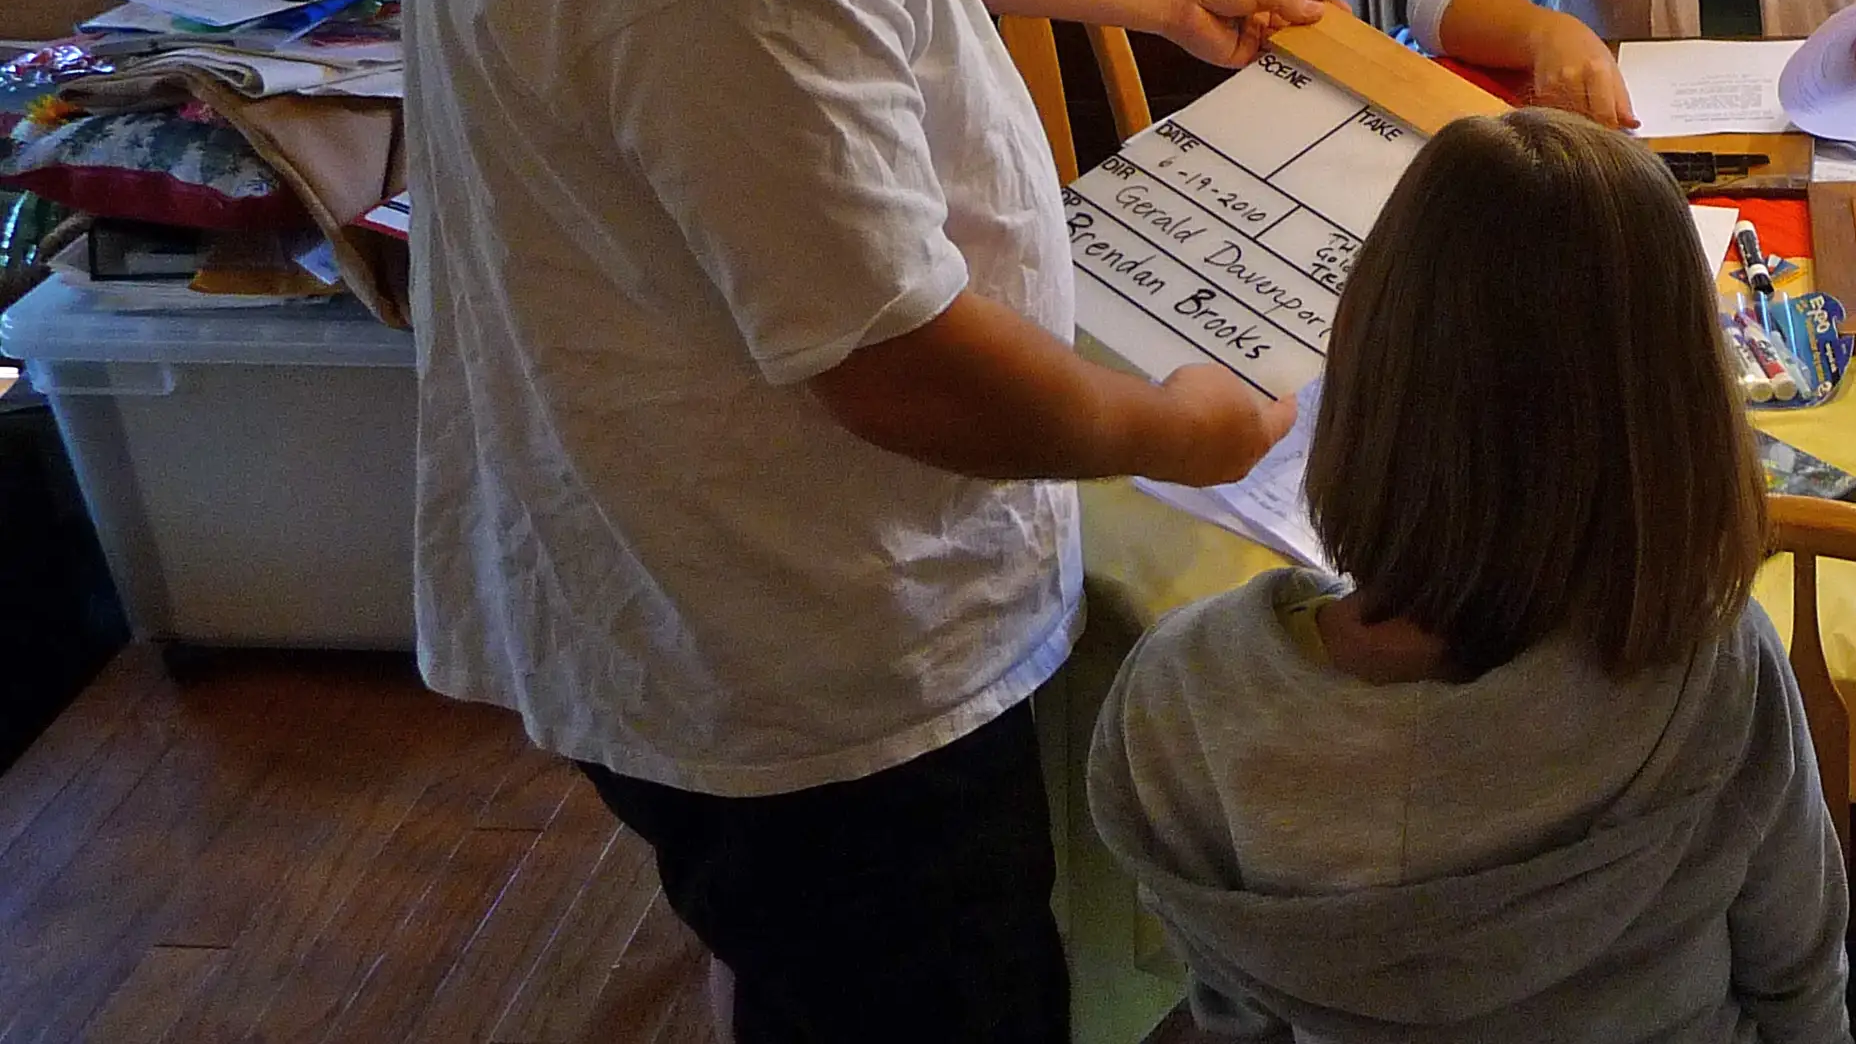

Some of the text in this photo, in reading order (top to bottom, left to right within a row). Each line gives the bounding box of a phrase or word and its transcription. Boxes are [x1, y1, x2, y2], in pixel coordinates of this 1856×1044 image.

[1258, 54, 1312, 89] SCENE
[1154, 122, 1200, 153] DATE
[1357, 108, 1403, 142] TAKE
[1101, 157, 1136, 181] DIR
[1115, 184, 1207, 243] Gerald
[1066, 212, 1271, 359] Brendan Brooks
